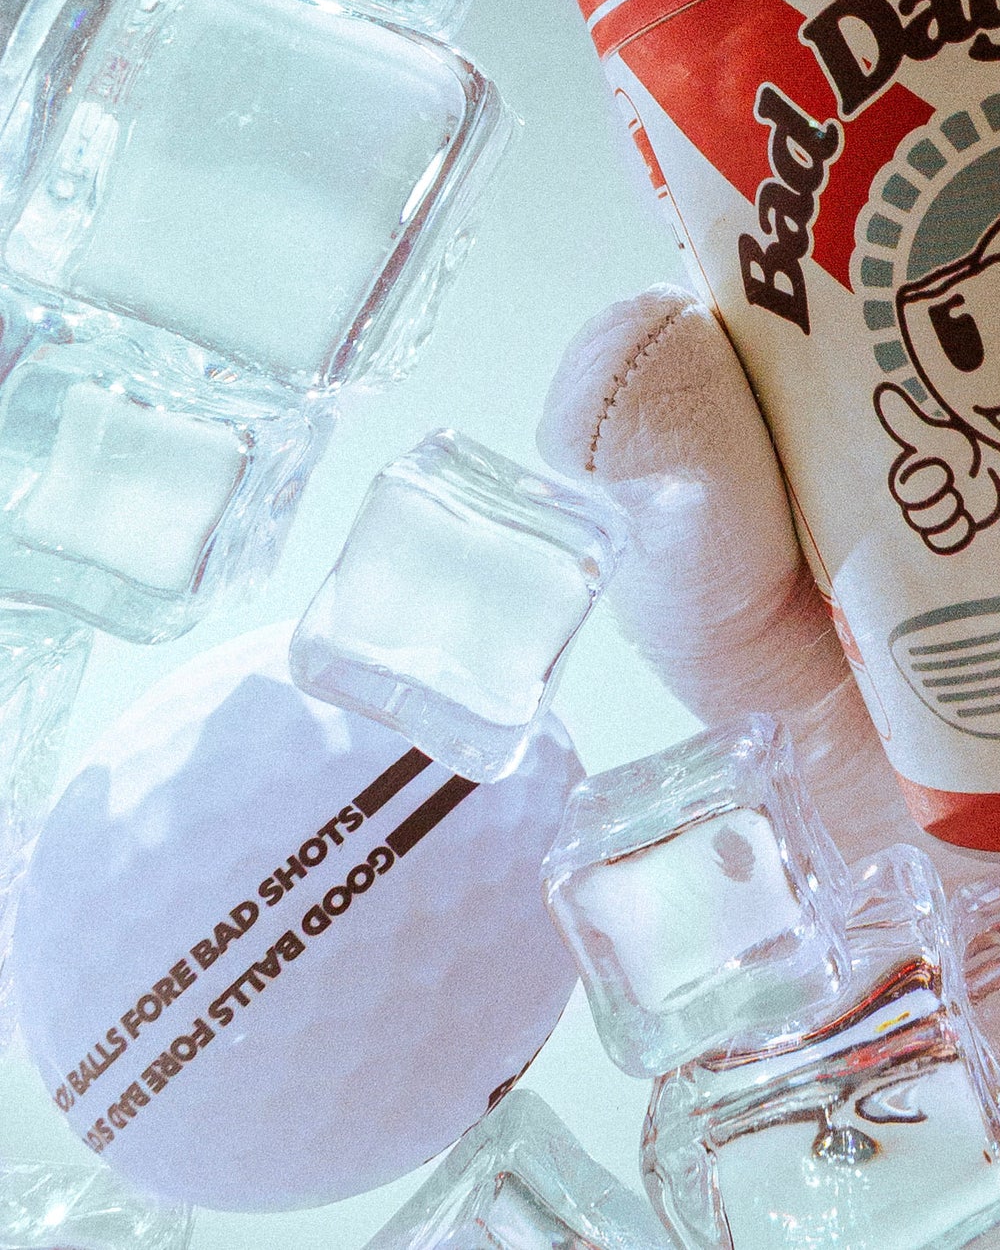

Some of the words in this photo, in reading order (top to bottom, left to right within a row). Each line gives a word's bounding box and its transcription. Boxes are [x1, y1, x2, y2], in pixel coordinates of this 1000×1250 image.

[737, 84, 841, 335] Bad
[301, 845, 395, 937] GOOD
[67, 1027, 127, 1096] BALLS
[120, 959, 198, 1039] FORE
[190, 900, 259, 971] BAD
[258, 806, 364, 907] SHOTS
[208, 930, 306, 1027] BALLS
[141, 1017, 216, 1094] FORE
